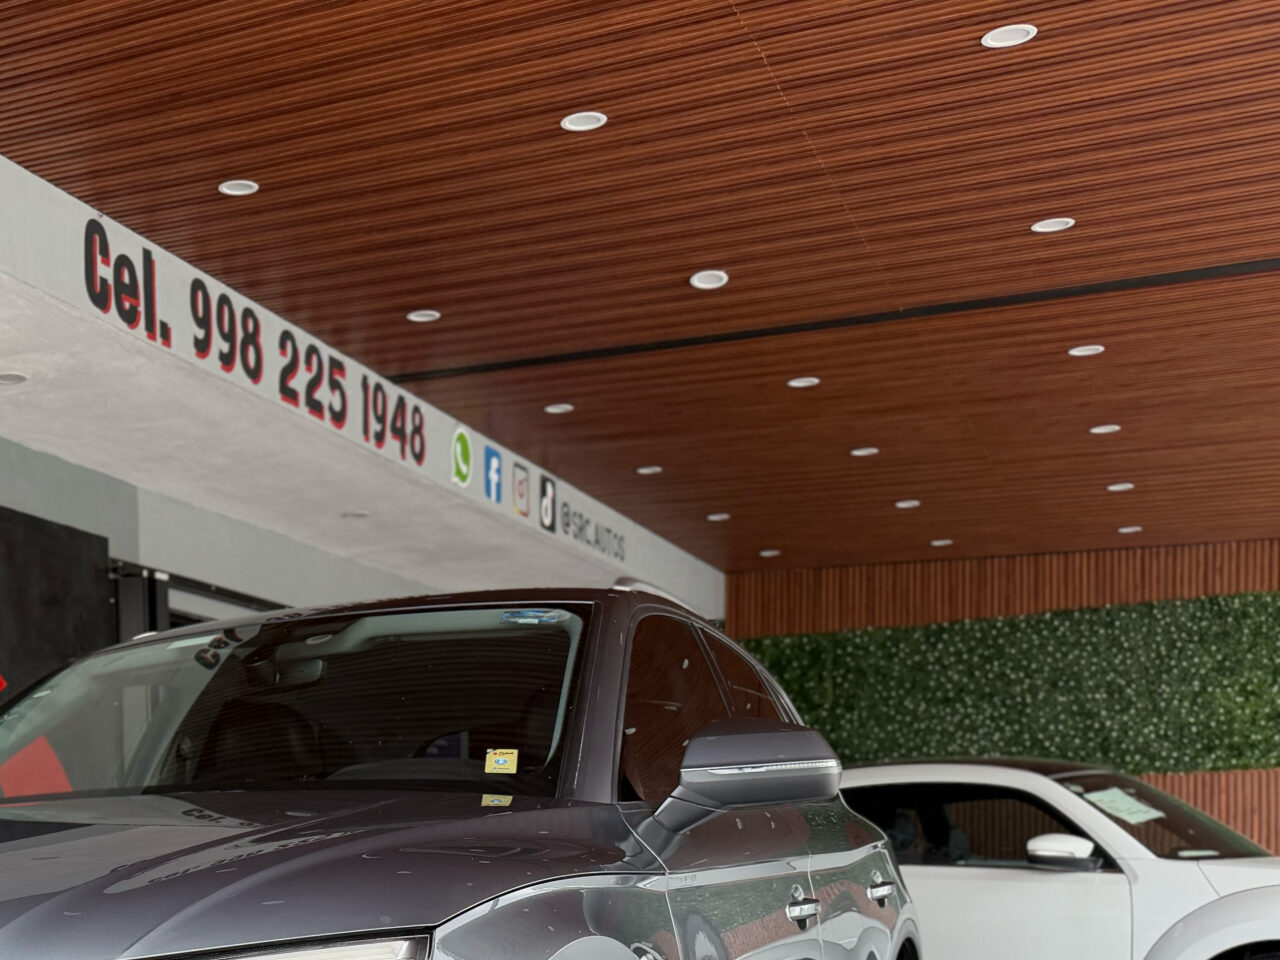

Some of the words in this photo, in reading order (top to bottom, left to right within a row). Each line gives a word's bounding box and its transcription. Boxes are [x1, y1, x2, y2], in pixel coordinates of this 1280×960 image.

[84, 218, 172, 348] Cel.
[189, 278, 263, 385] 998
[277, 330, 347, 430] 225
[361, 374, 426, 466] 1948
